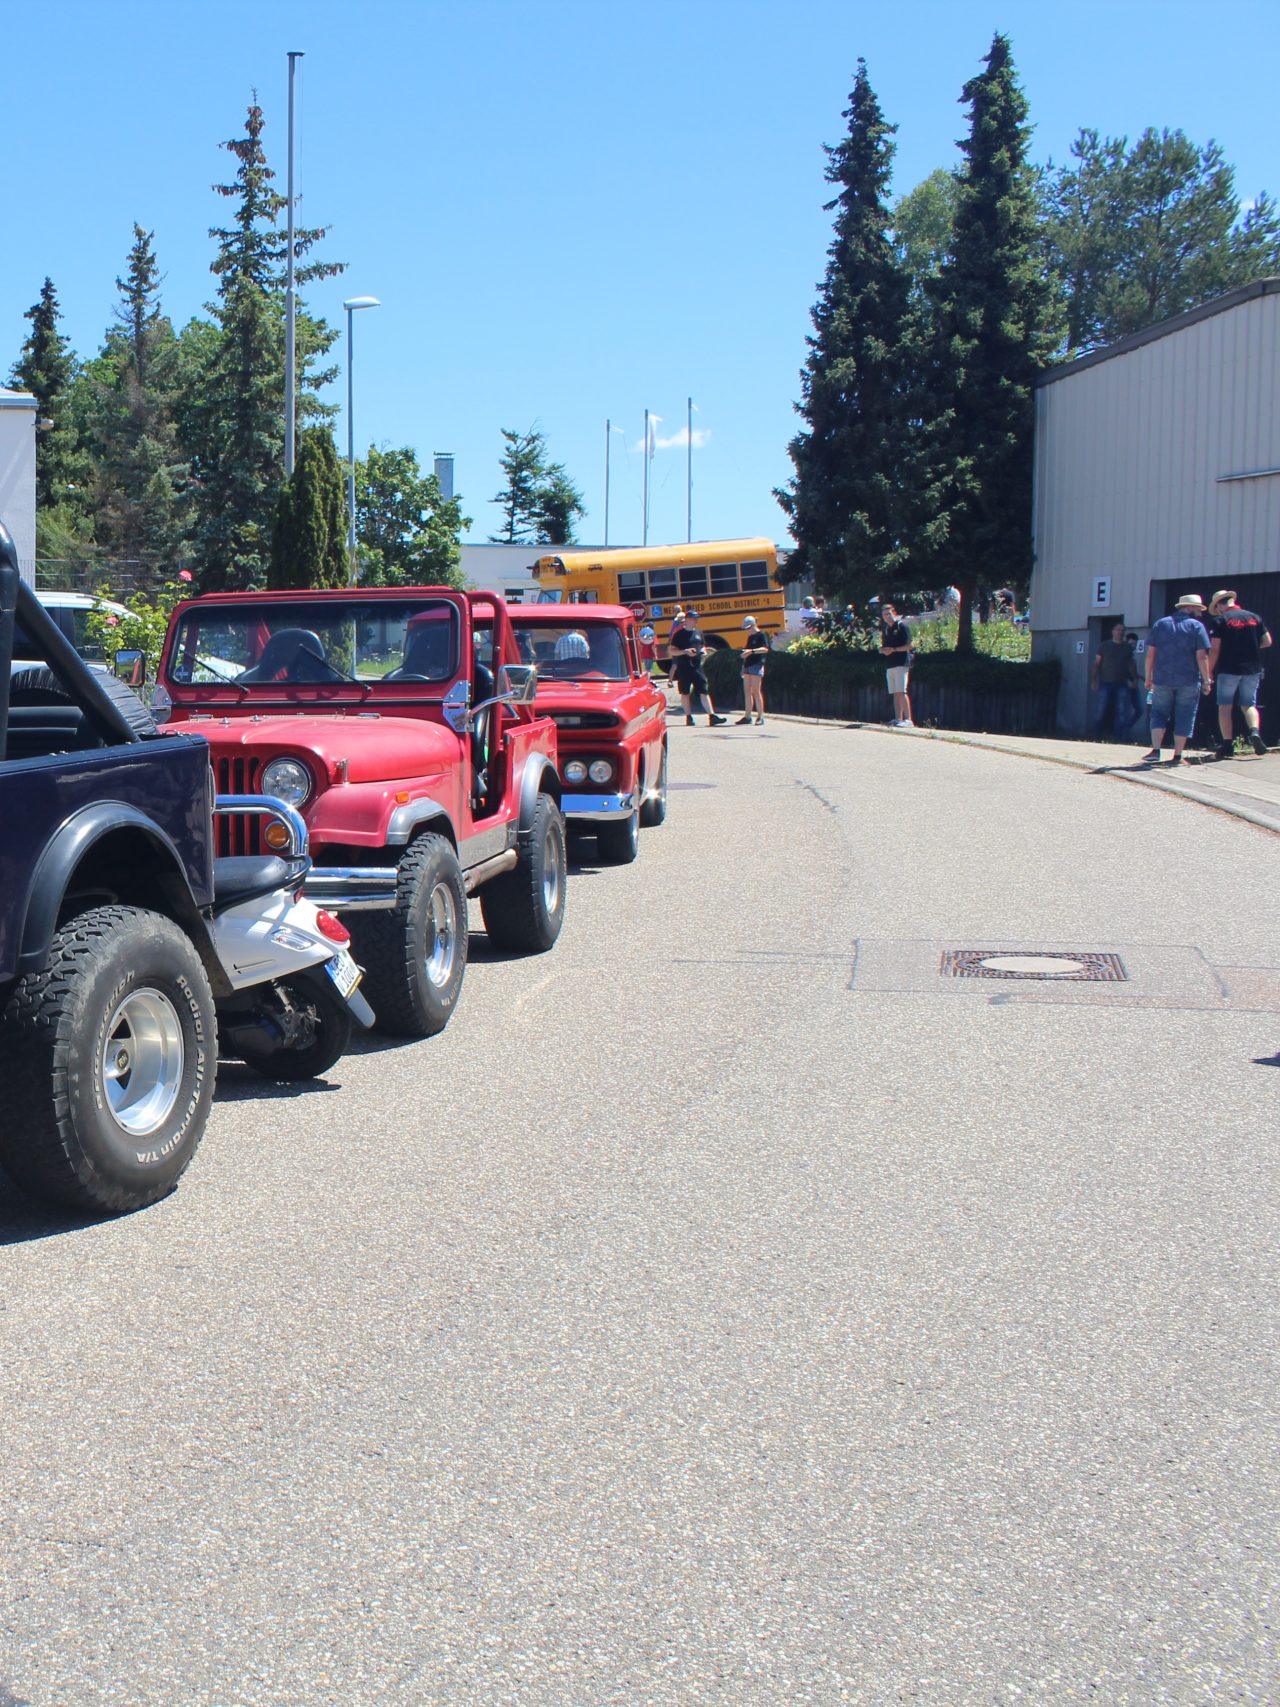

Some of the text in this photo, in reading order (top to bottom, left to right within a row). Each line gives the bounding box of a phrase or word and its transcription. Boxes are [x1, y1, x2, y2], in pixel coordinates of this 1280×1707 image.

[709, 601, 731, 610] SCHOOL
[734, 599, 760, 608] DISTRICT
[1097, 581, 1106, 602] E
[94, 969, 135, 1110] BFGoodrich
[136, 975, 206, 1164] Radial All-Terrain T/A
